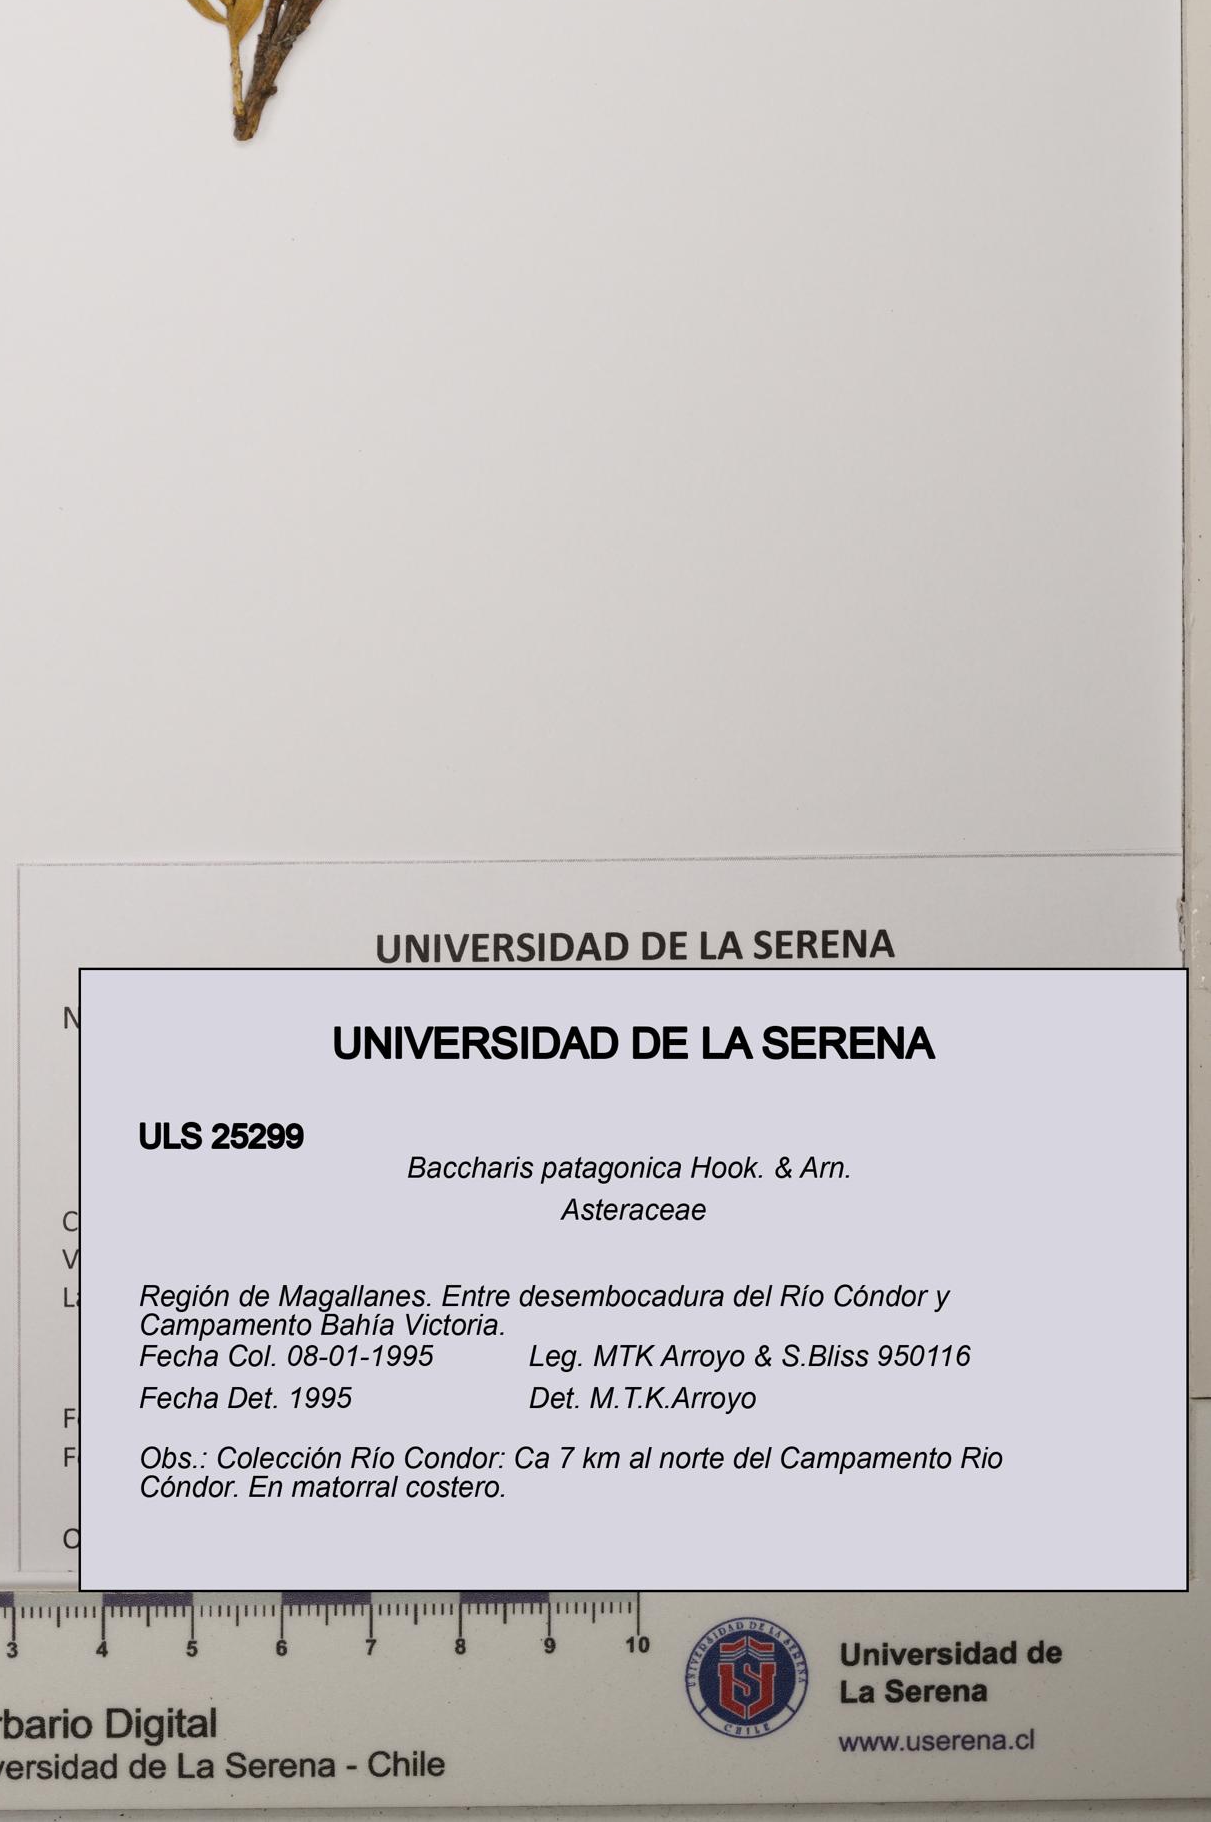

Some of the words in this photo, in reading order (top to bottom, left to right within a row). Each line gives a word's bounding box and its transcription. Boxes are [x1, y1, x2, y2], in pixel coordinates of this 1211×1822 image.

[376, 931, 630, 964] UNIVERSIDAD
[641, 931, 688, 961] DE
[700, 930, 744, 961] LA
[753, 928, 896, 960] SERENA
[6, 1641, 19, 1658] 3
[95, 1641, 108, 1658] 4
[186, 1640, 198, 1657] 5
[276, 1639, 287, 1656] 6
[365, 1639, 377, 1655] 7
[455, 1638, 466, 1655] 8
[544, 1637, 556, 1653] 9
[626, 1636, 650, 1653] 10
[840, 1640, 1017, 1667] Universidad
[1026, 1639, 1063, 1665] de
[840, 1679, 875, 1704] La
[884, 1678, 988, 1704] Serena
[105, 1706, 217, 1747] Digital
[723, 1724, 771, 1735] CHILE
[838, 1728, 1035, 1753] www.userena.cl
[128, 1752, 167, 1780] de
[177, 1752, 215, 1780] La
[225, 1751, 336, 1779] Serena
[367, 1750, 446, 1778] Chile
